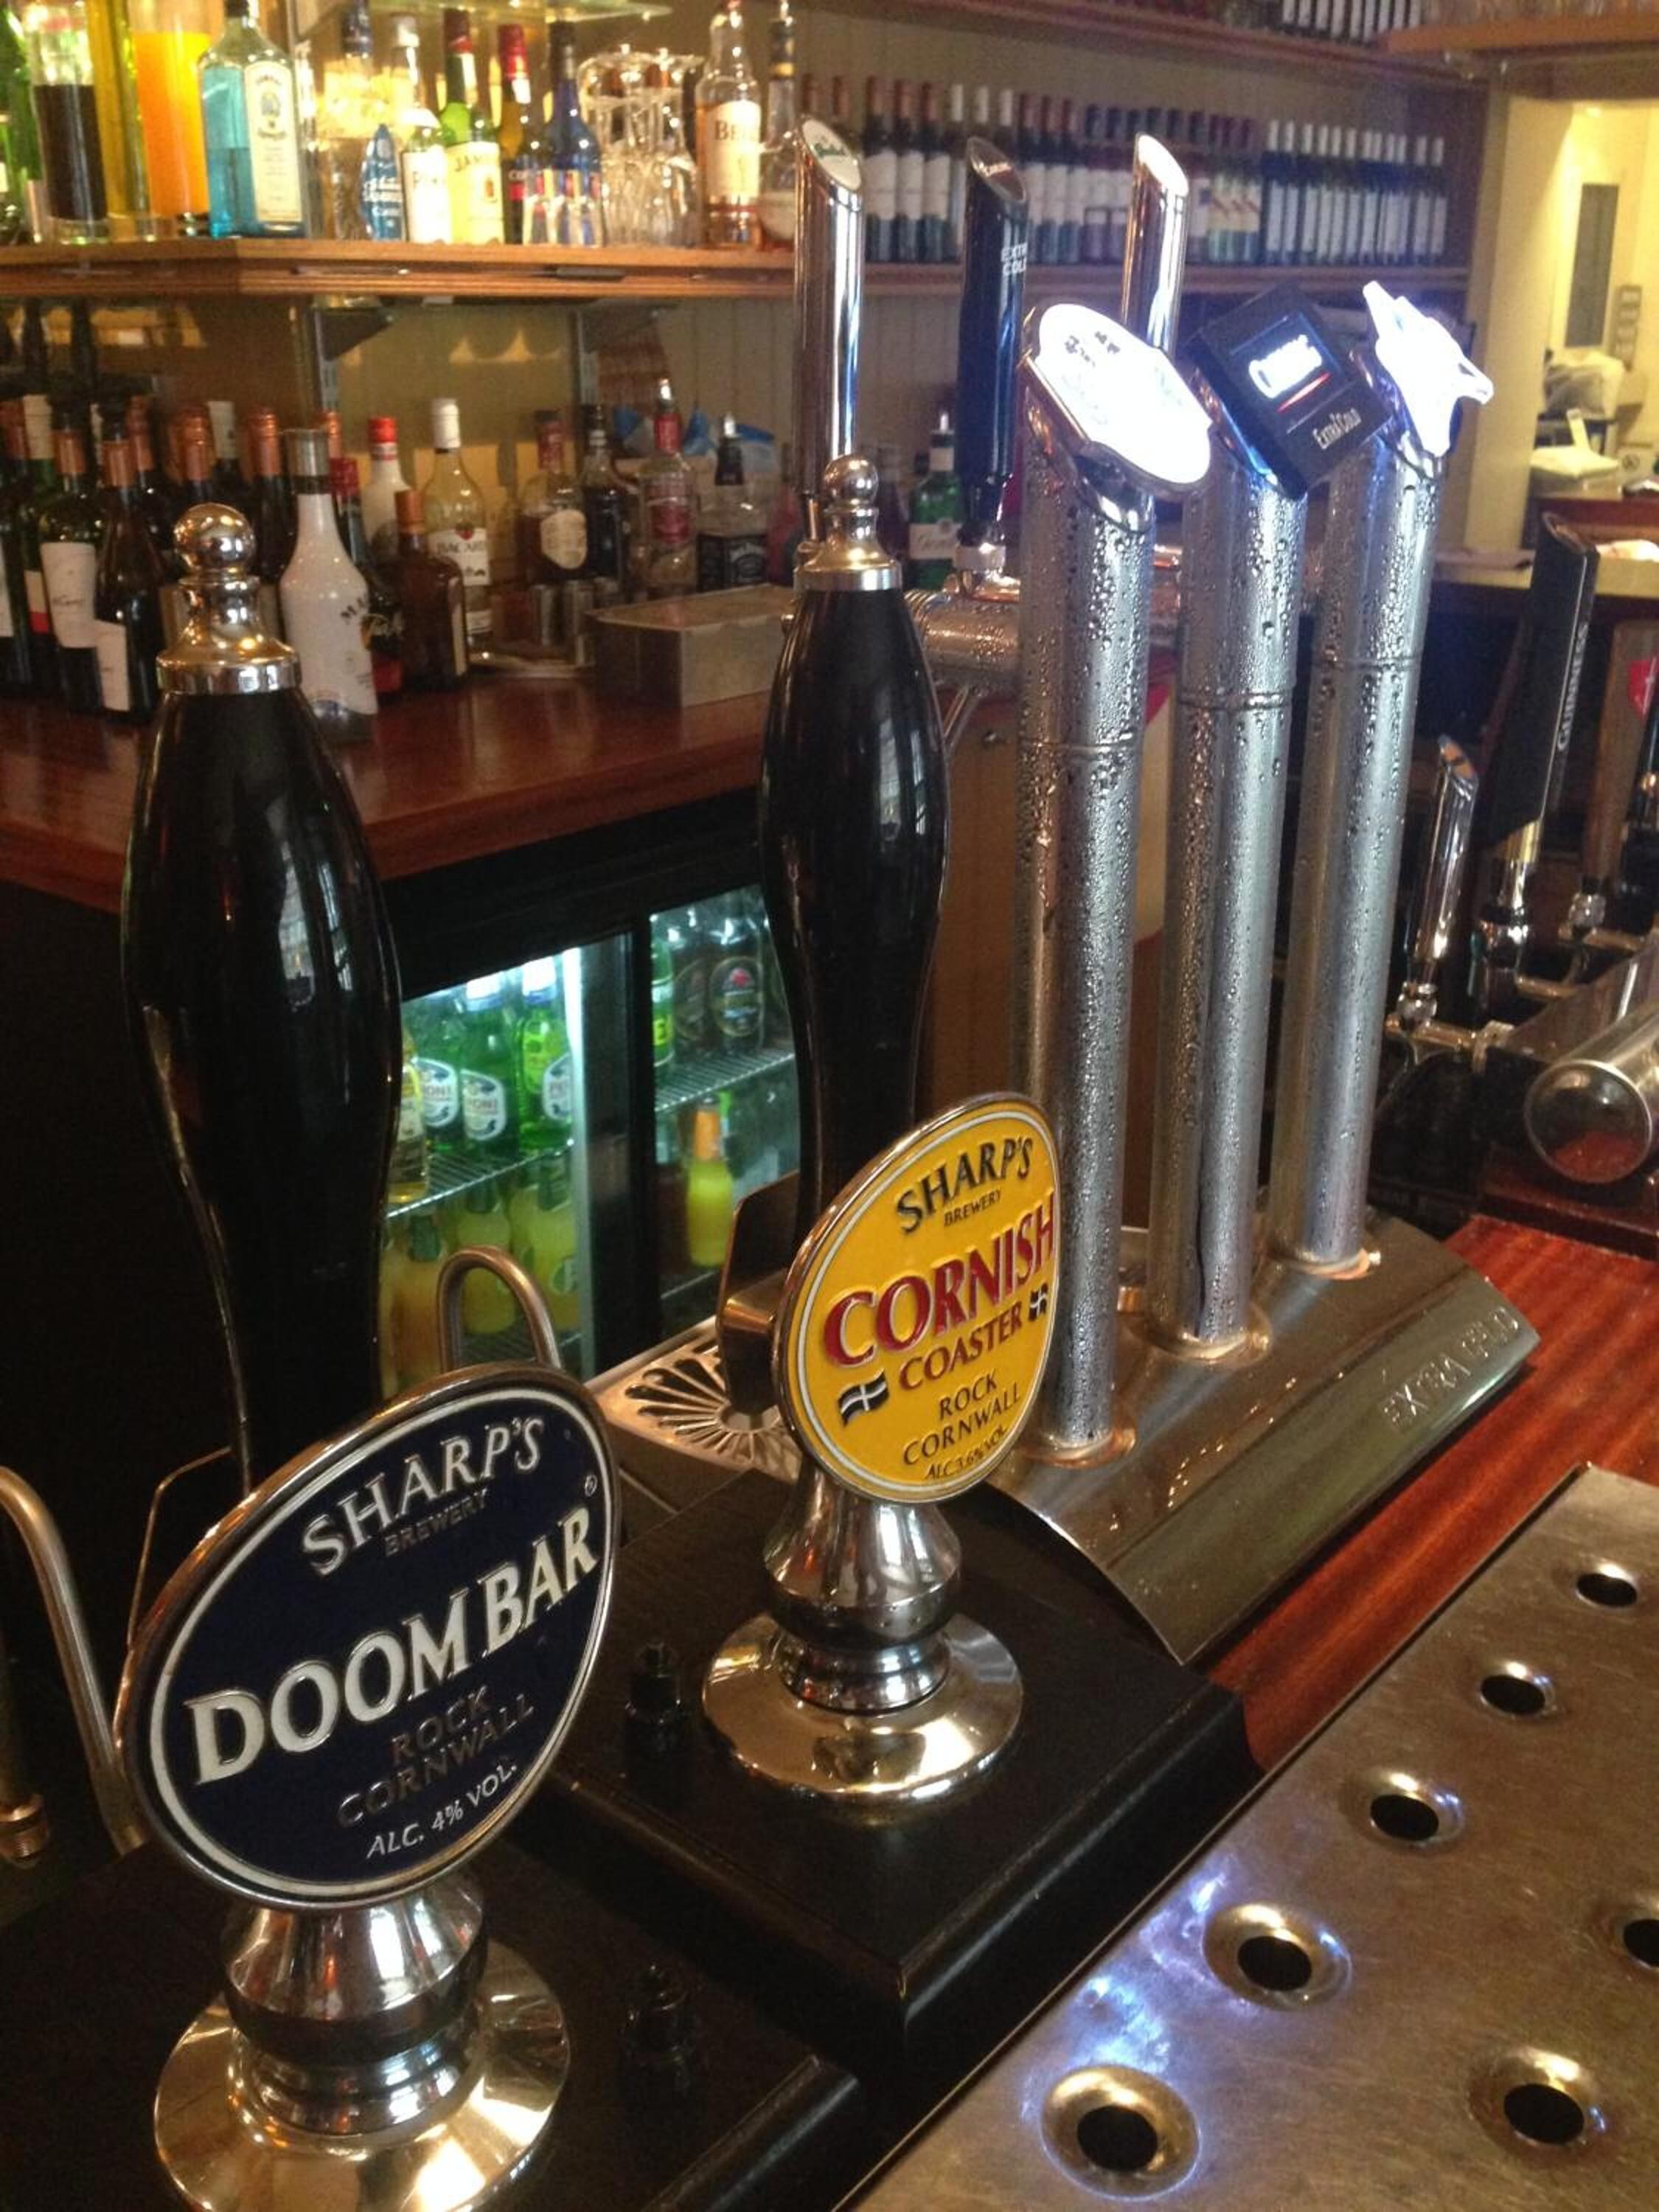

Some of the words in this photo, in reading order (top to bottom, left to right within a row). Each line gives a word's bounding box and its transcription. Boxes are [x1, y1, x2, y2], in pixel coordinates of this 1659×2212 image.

[897, 1137, 1034, 1234] SHARP'S
[945, 1189, 1001, 1228] BREWERY
[824, 1192, 1055, 1369] CORNISH
[899, 1301, 1024, 1391] COASTER
[1380, 1352, 1472, 1430] EXTRA
[903, 1382, 1021, 1467] CORNWALL
[939, 1368, 998, 1422] ROCK
[302, 1417, 544, 1576] SHARP'S
[384, 1488, 488, 1557] BREWERY
[183, 1589, 472, 1786] DOOM
[477, 1507, 599, 1658] BAR
[338, 1694, 535, 1829] CORNWALL
[390, 1685, 488, 1766] ROCK
[366, 1823, 425, 1860] ALC.
[431, 1799, 465, 1832] 4%
[466, 1764, 517, 1807] VOL.
